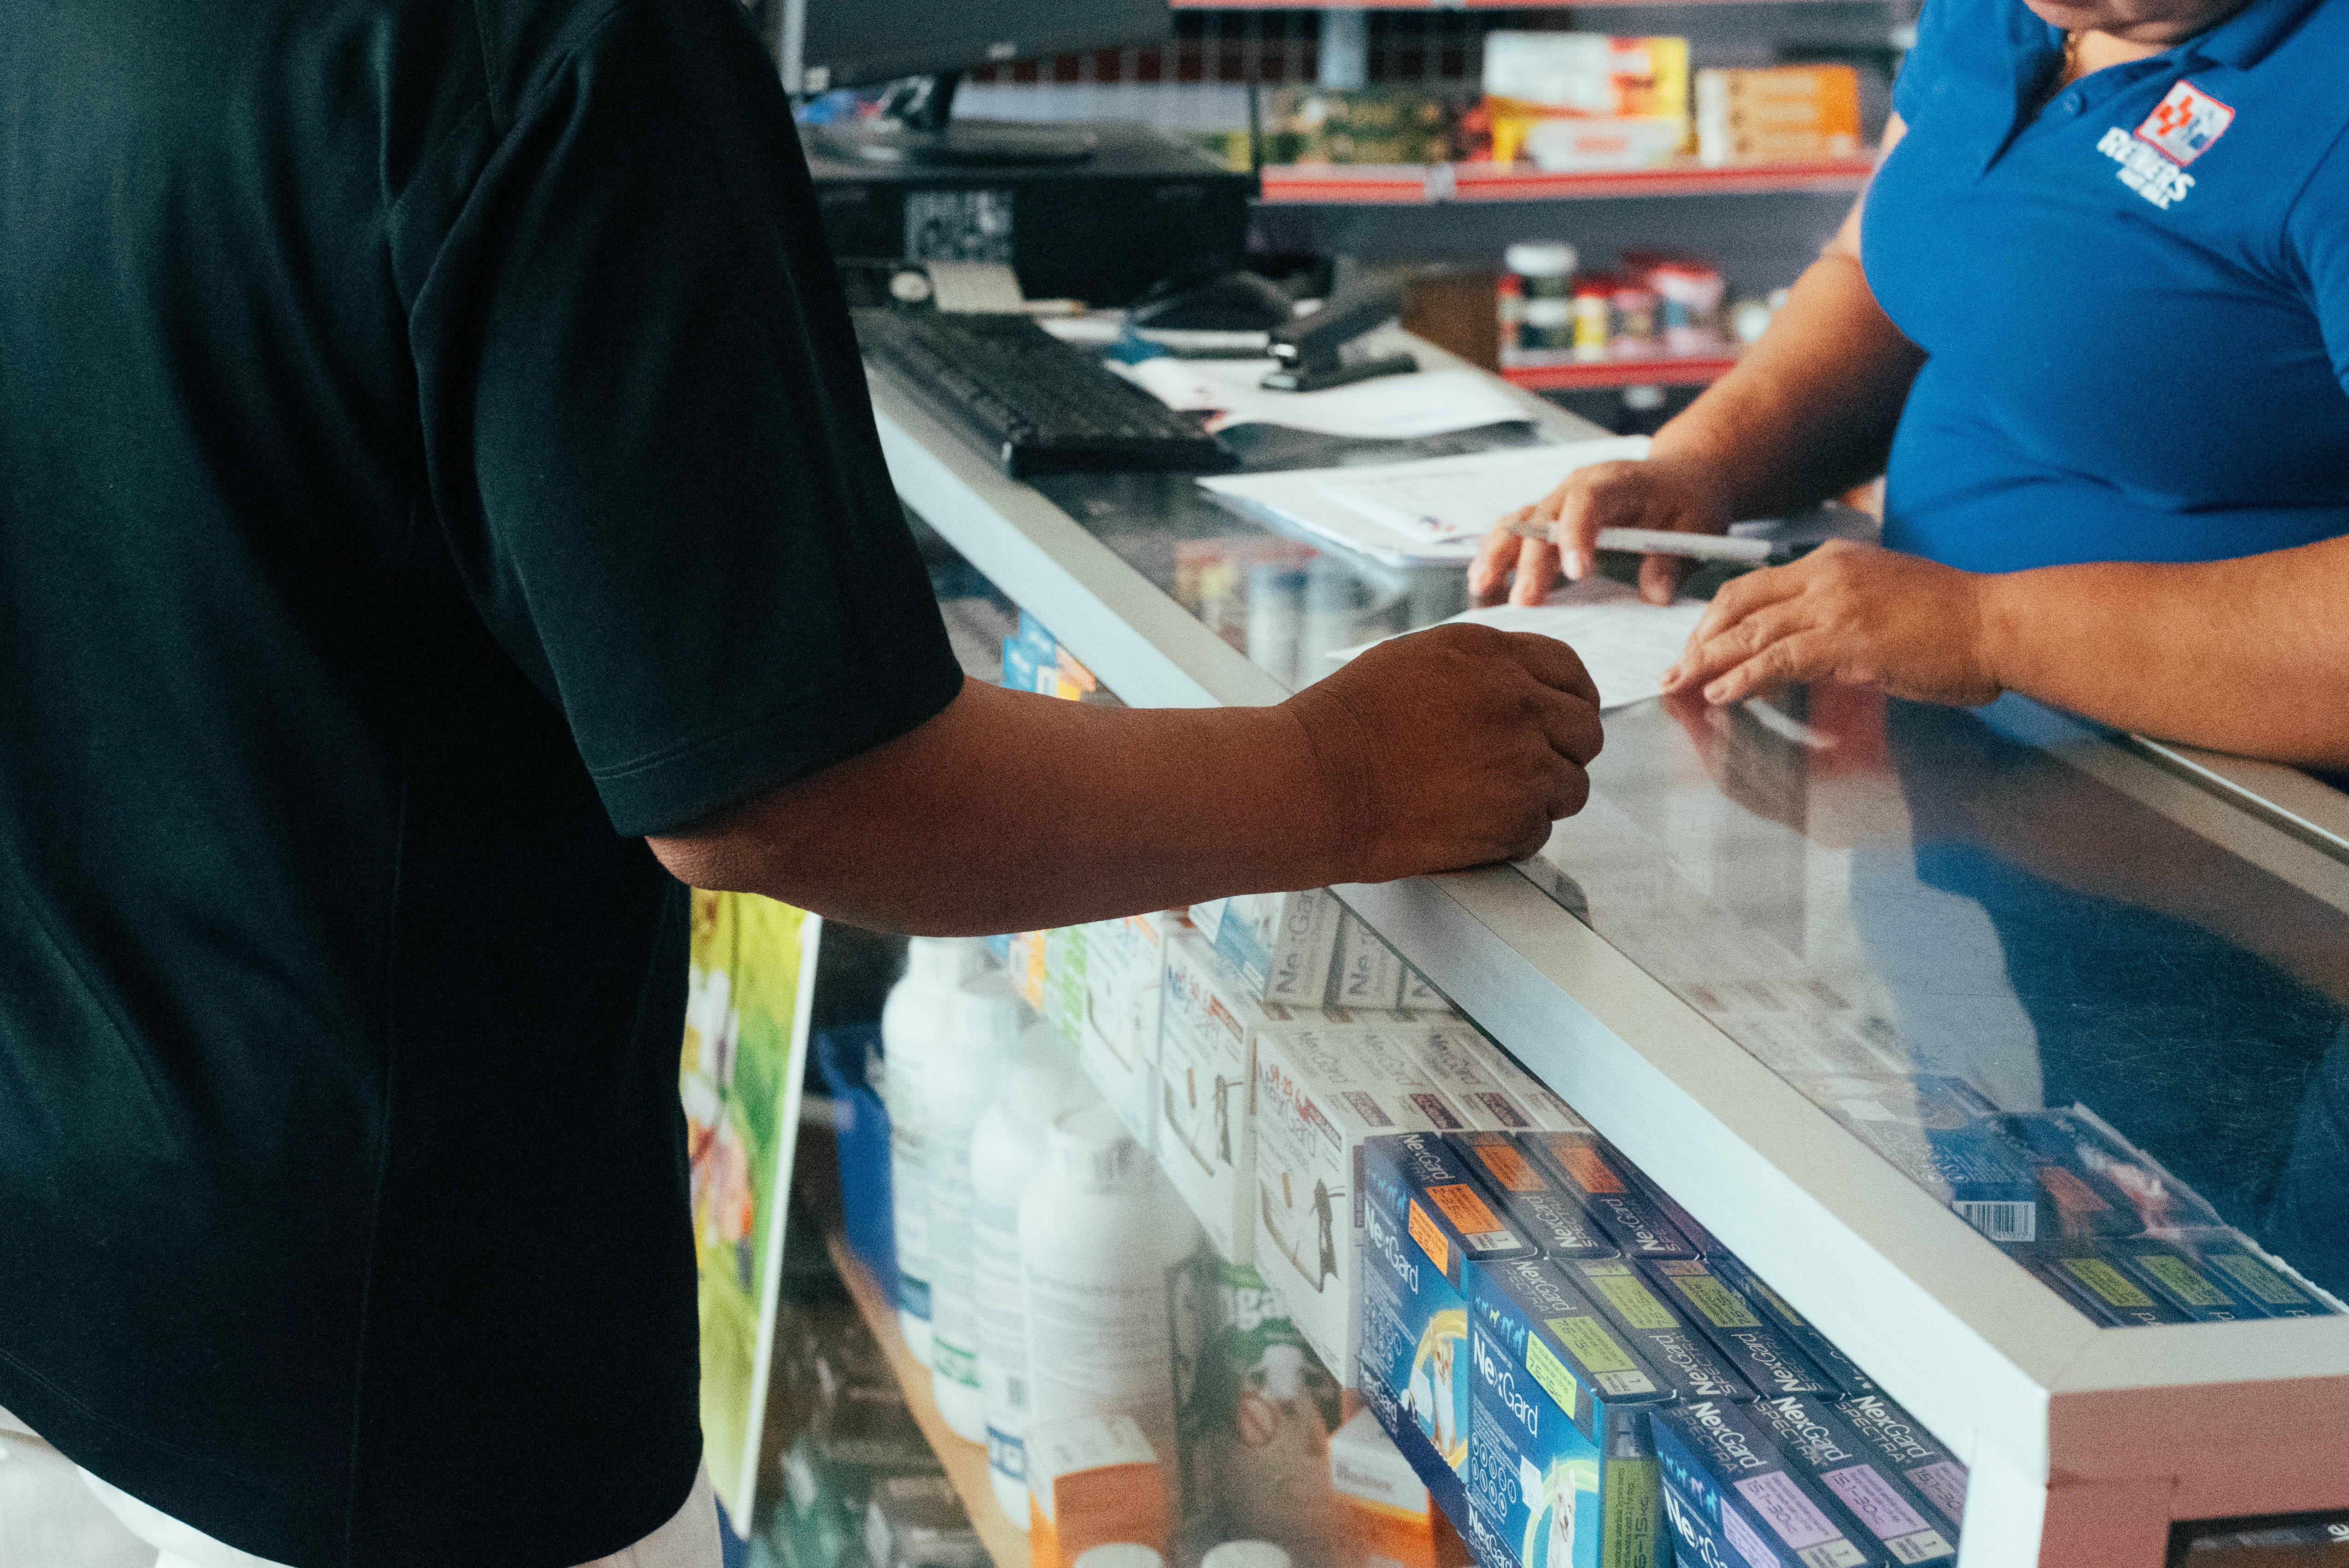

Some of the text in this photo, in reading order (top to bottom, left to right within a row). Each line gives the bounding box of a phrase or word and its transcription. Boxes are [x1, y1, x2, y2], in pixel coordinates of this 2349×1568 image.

[1399, 1133, 1456, 1180] NexGard
[1365, 1200, 1418, 1295] NexGard
[1600, 1199, 1666, 1251] NexGard
[1510, 1261, 1578, 1311] NexGard
[1474, 1330, 1539, 1438] NexGard
[1648, 1333, 1722, 1395] NexGard
[1731, 1333, 1808, 1392] NexGard
[1687, 1400, 1768, 1469] NexGard
[1770, 1395, 1853, 1461] NexGard
[1851, 1394, 1935, 1458] NexGard
